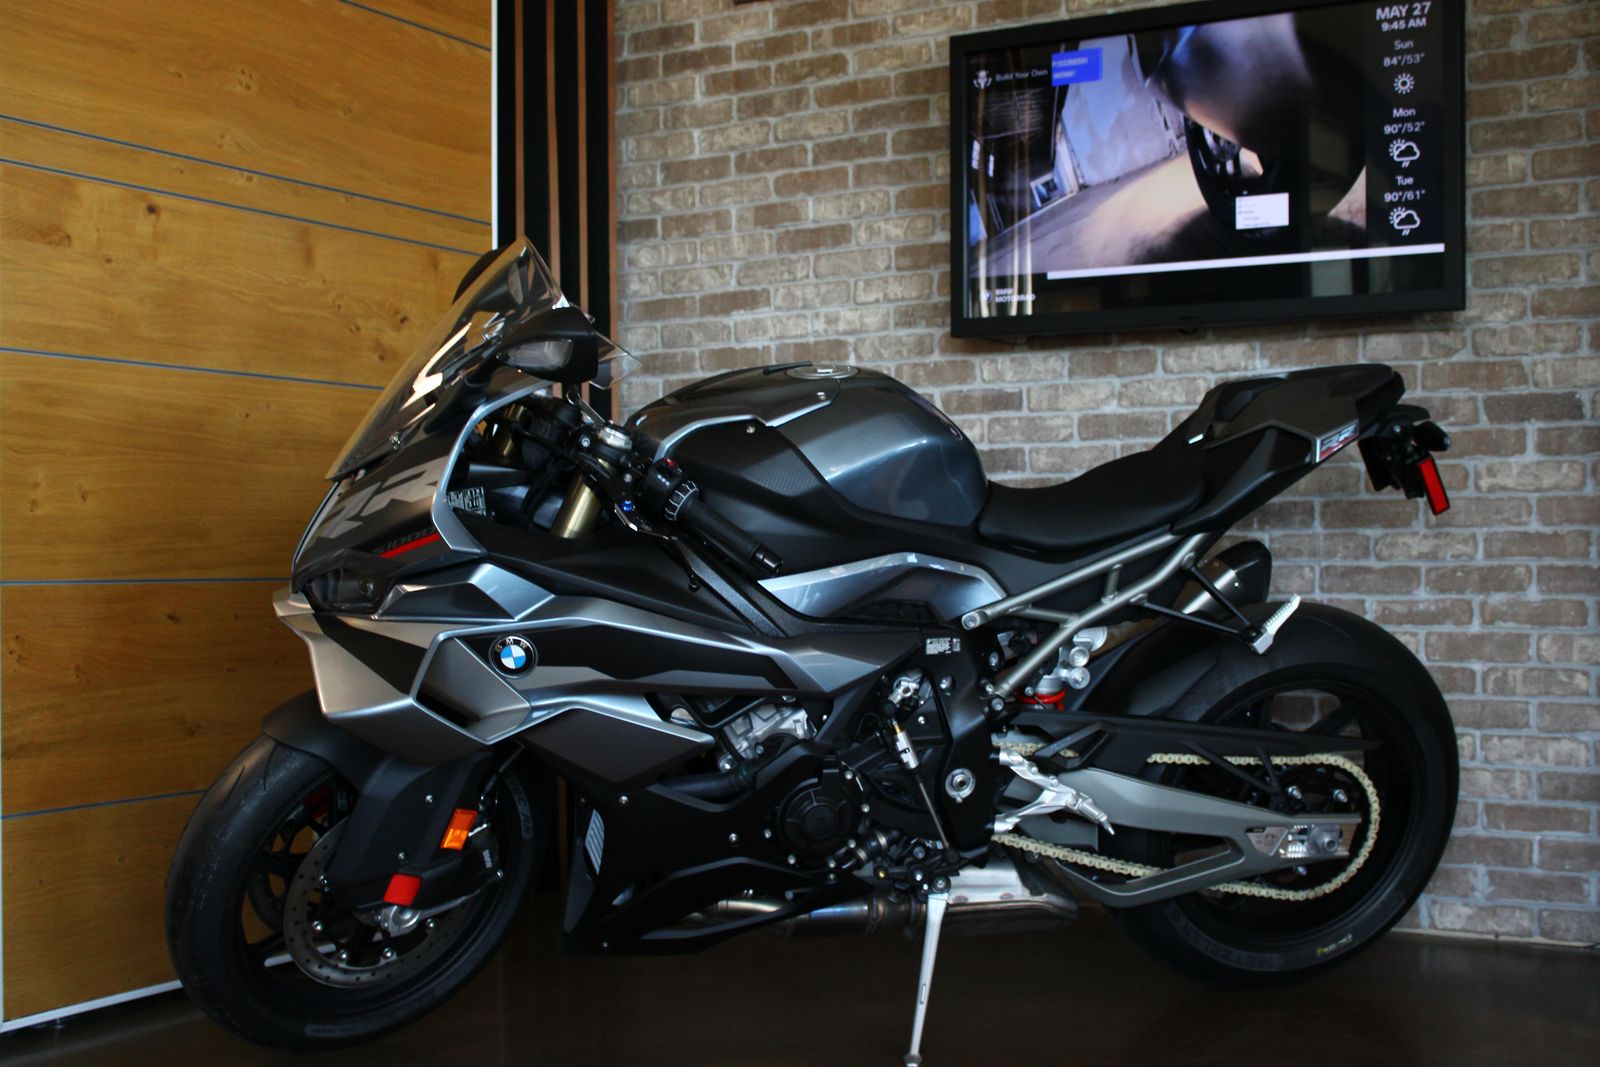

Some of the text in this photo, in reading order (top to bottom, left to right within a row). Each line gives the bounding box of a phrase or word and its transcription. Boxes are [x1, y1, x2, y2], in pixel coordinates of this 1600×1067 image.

[1376, 1, 1432, 20] MAY 27
[1381, 17, 1427, 32] 9:45 AM
[1394, 40, 1414, 50] Sun
[1031, 68, 1048, 77] Own
[1392, 108, 1416, 118] Mon
[1395, 175, 1414, 185] Tue
[496, 638, 528, 652] BMW
